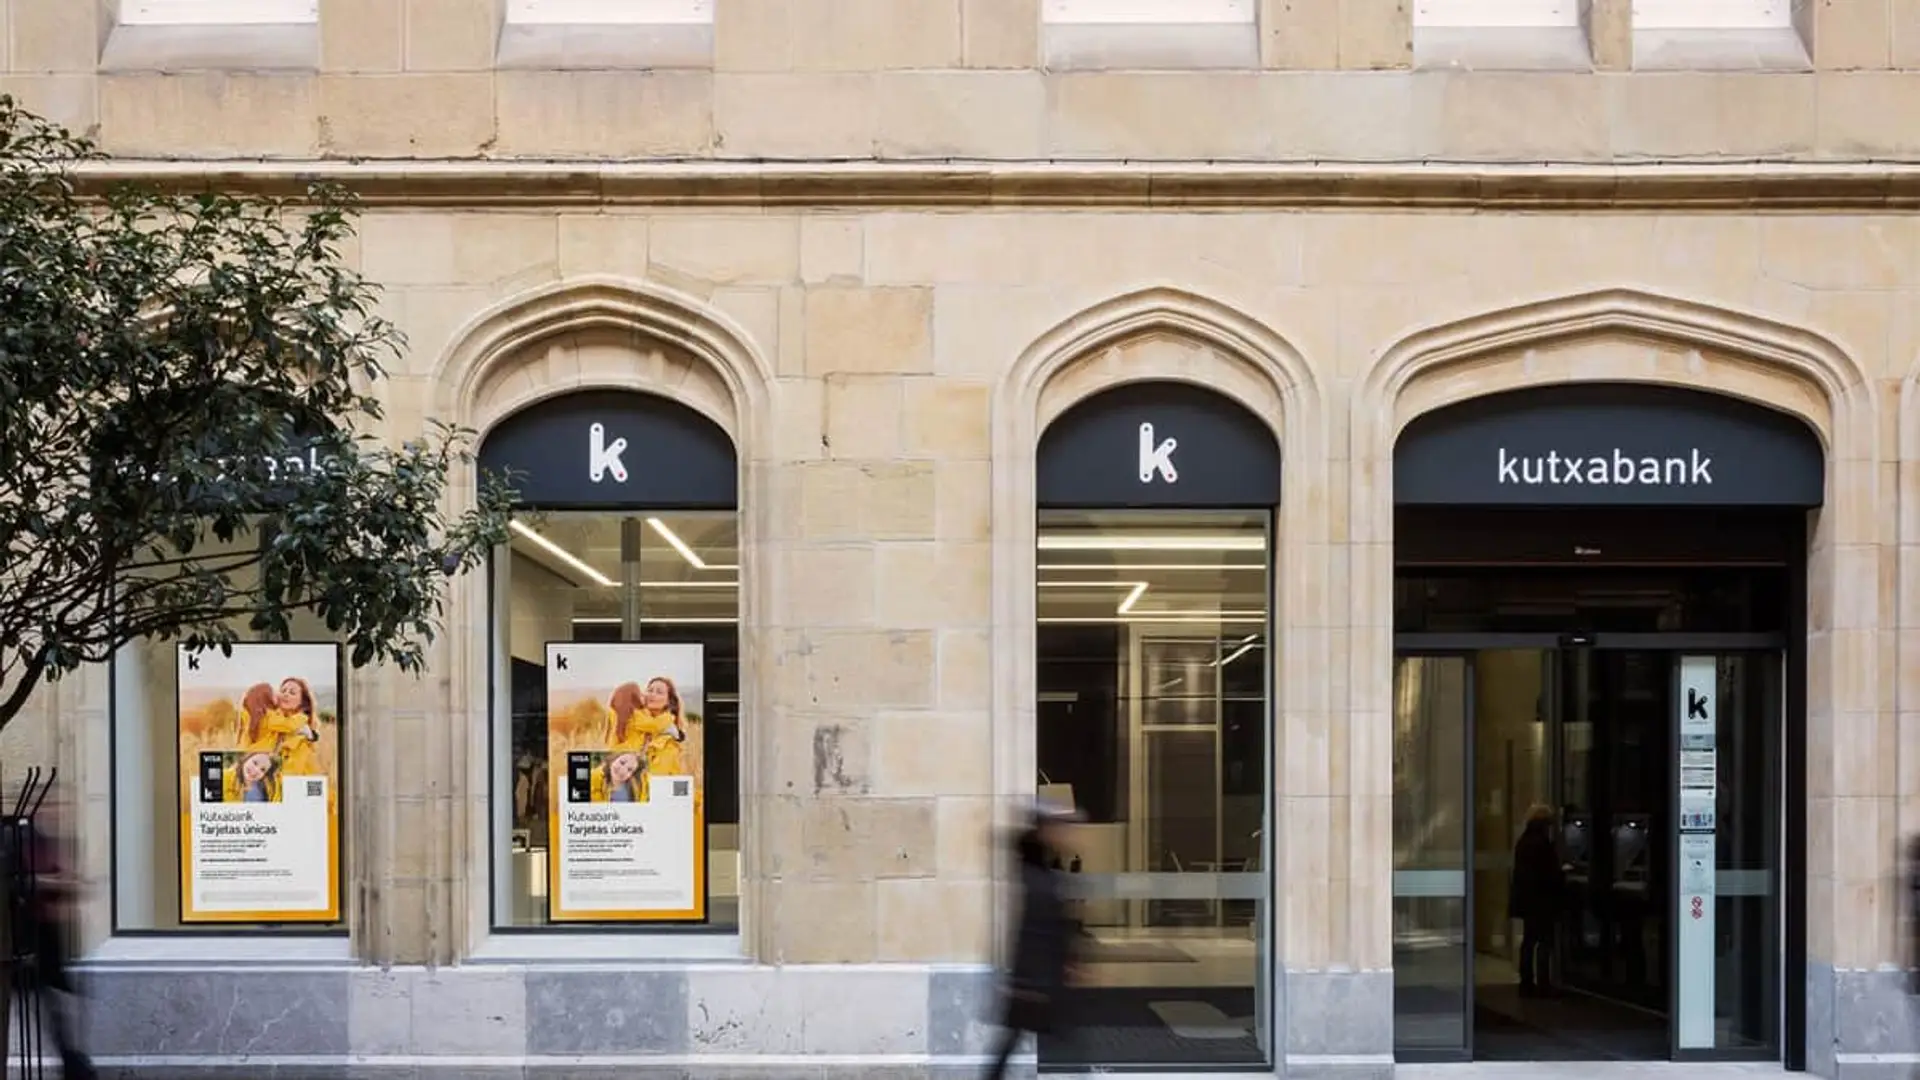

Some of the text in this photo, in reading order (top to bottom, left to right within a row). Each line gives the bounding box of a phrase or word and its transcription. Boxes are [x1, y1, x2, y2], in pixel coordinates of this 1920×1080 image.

[589, 422, 628, 483] k
[1139, 422, 1178, 483] k
[1498, 448, 1712, 484] kutxabank
[188, 653, 200, 670] k
[556, 652, 568, 670] k
[1688, 687, 1708, 719] k
[204, 787, 213, 799] k
[572, 787, 580, 799] k
[200, 811, 254, 821] Kutxabank
[567, 811, 620, 821] Kutxabank
[200, 823, 277, 837] Tarjetas únicas
[568, 823, 644, 837] Tarjetas únicas
